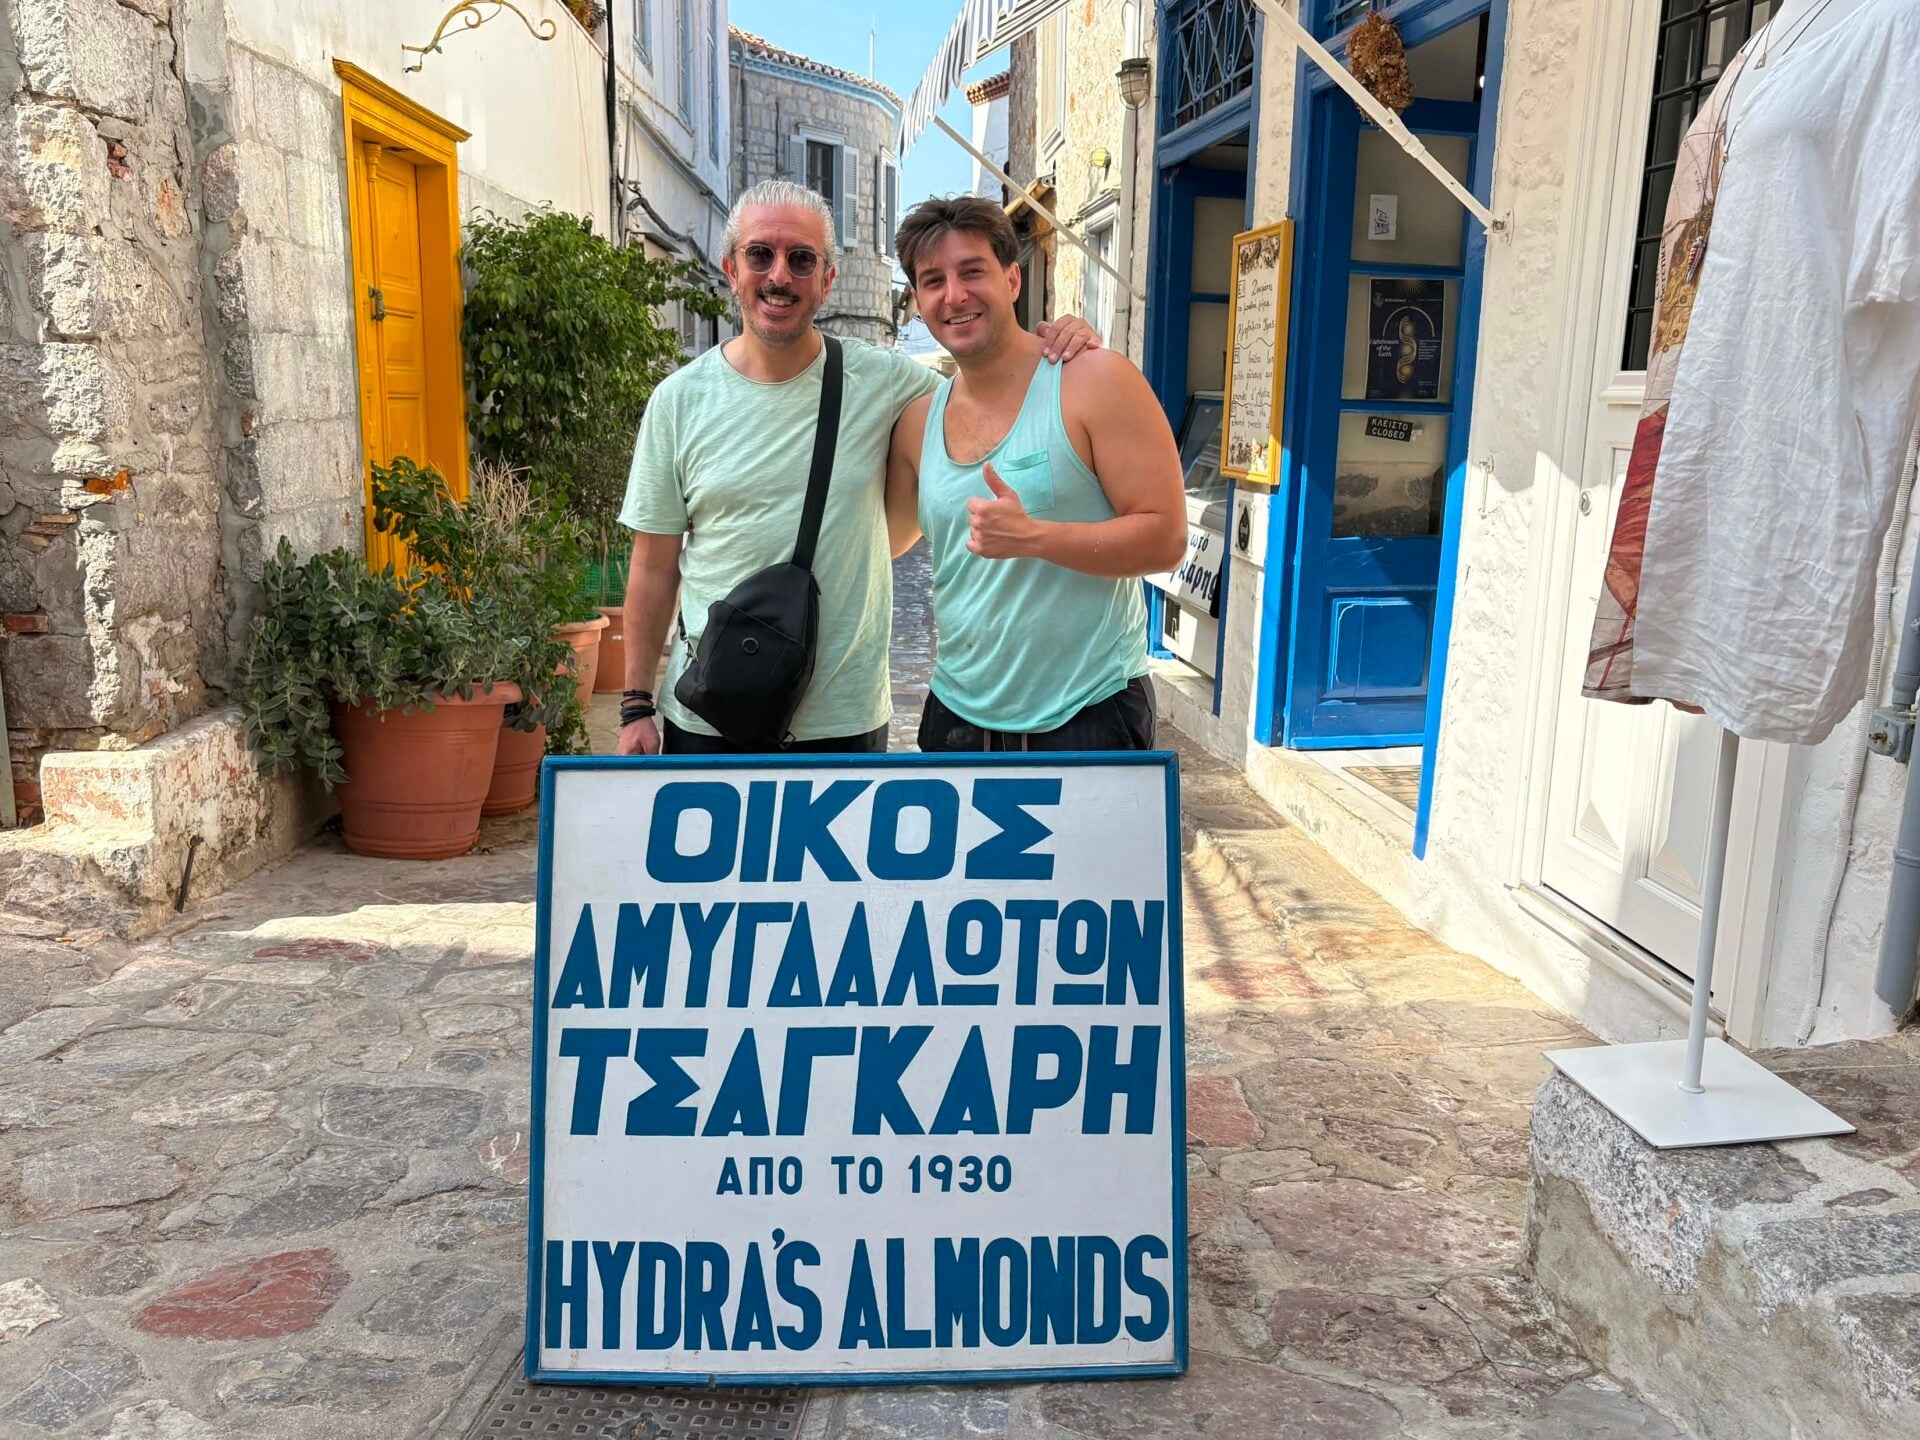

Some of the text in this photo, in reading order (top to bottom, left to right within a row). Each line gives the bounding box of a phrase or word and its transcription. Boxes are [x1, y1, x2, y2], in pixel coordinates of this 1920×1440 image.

[1371, 418, 1409, 431] ΚΛΕΙΣΤΟ
[1371, 427, 1405, 440] CLOSED
[1189, 533, 1212, 552] ωτό
[1170, 555, 1219, 601] κάρης
[645, 777, 1063, 883] ΟΙΚΟΣ
[551, 898, 1165, 1009] ΑΜΥΓΔΑΛΩΤΩΝ
[558, 1024, 1162, 1137] ΤΣΑΓΚΑΡΗ
[716, 1154, 1013, 1195] ΑΠΟ ΤΟ 1930
[544, 1227, 1170, 1352] HYDRA'S ALMONDS
